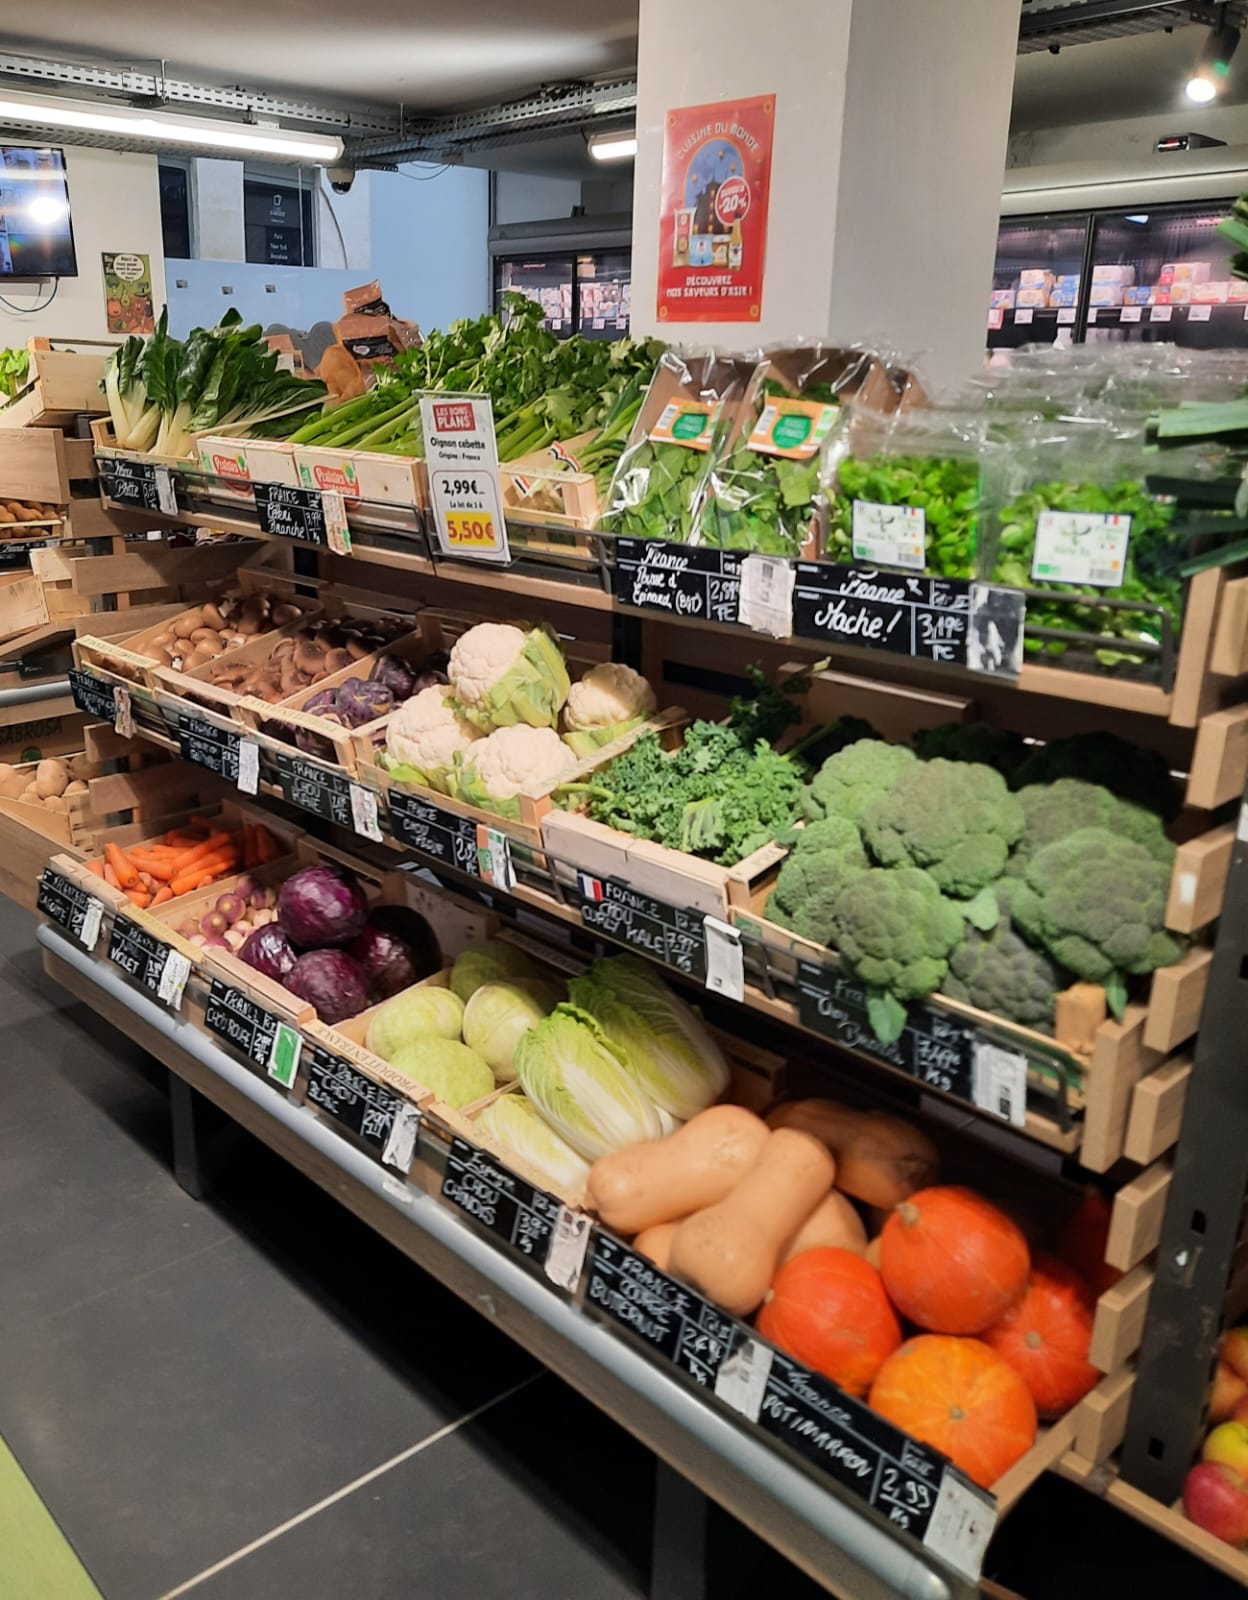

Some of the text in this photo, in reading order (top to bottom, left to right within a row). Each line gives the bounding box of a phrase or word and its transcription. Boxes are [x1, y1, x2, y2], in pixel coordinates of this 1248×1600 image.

[677, 125, 711, 160] CUISINE
[715, 122, 728, 134] DU
[666, 288, 682, 297] NOS
[683, 286, 719, 297] SAVEURS
[721, 286, 747, 297] D'ASIE
[686, 275, 732, 286] DÉCOUVREZ
[435, 407, 449, 416] LES
[437, 415, 470, 429] PLANS
[430, 436, 457, 449] Oignon
[462, 452, 481, 461] France
[441, 479, 478, 497] 2,99€
[268, 520, 305, 539] Branche
[446, 519, 494, 542] 5,50€
[640, 541, 689, 571] France
[839, 570, 906, 604] France
[292, 760, 328, 785] FRANCE
[605, 882, 661, 919] FRANCE
[598, 902, 634, 926] CHOU
[625, 926, 665, 955] KALE
[110, 946, 140, 974] VIOLET
[320, 1075, 358, 1105] CHOU
[461, 1173, 500, 1205] CHOU
[619, 1255, 691, 1312] FRANCE
[762, 1394, 873, 1478] POTIMARRON
